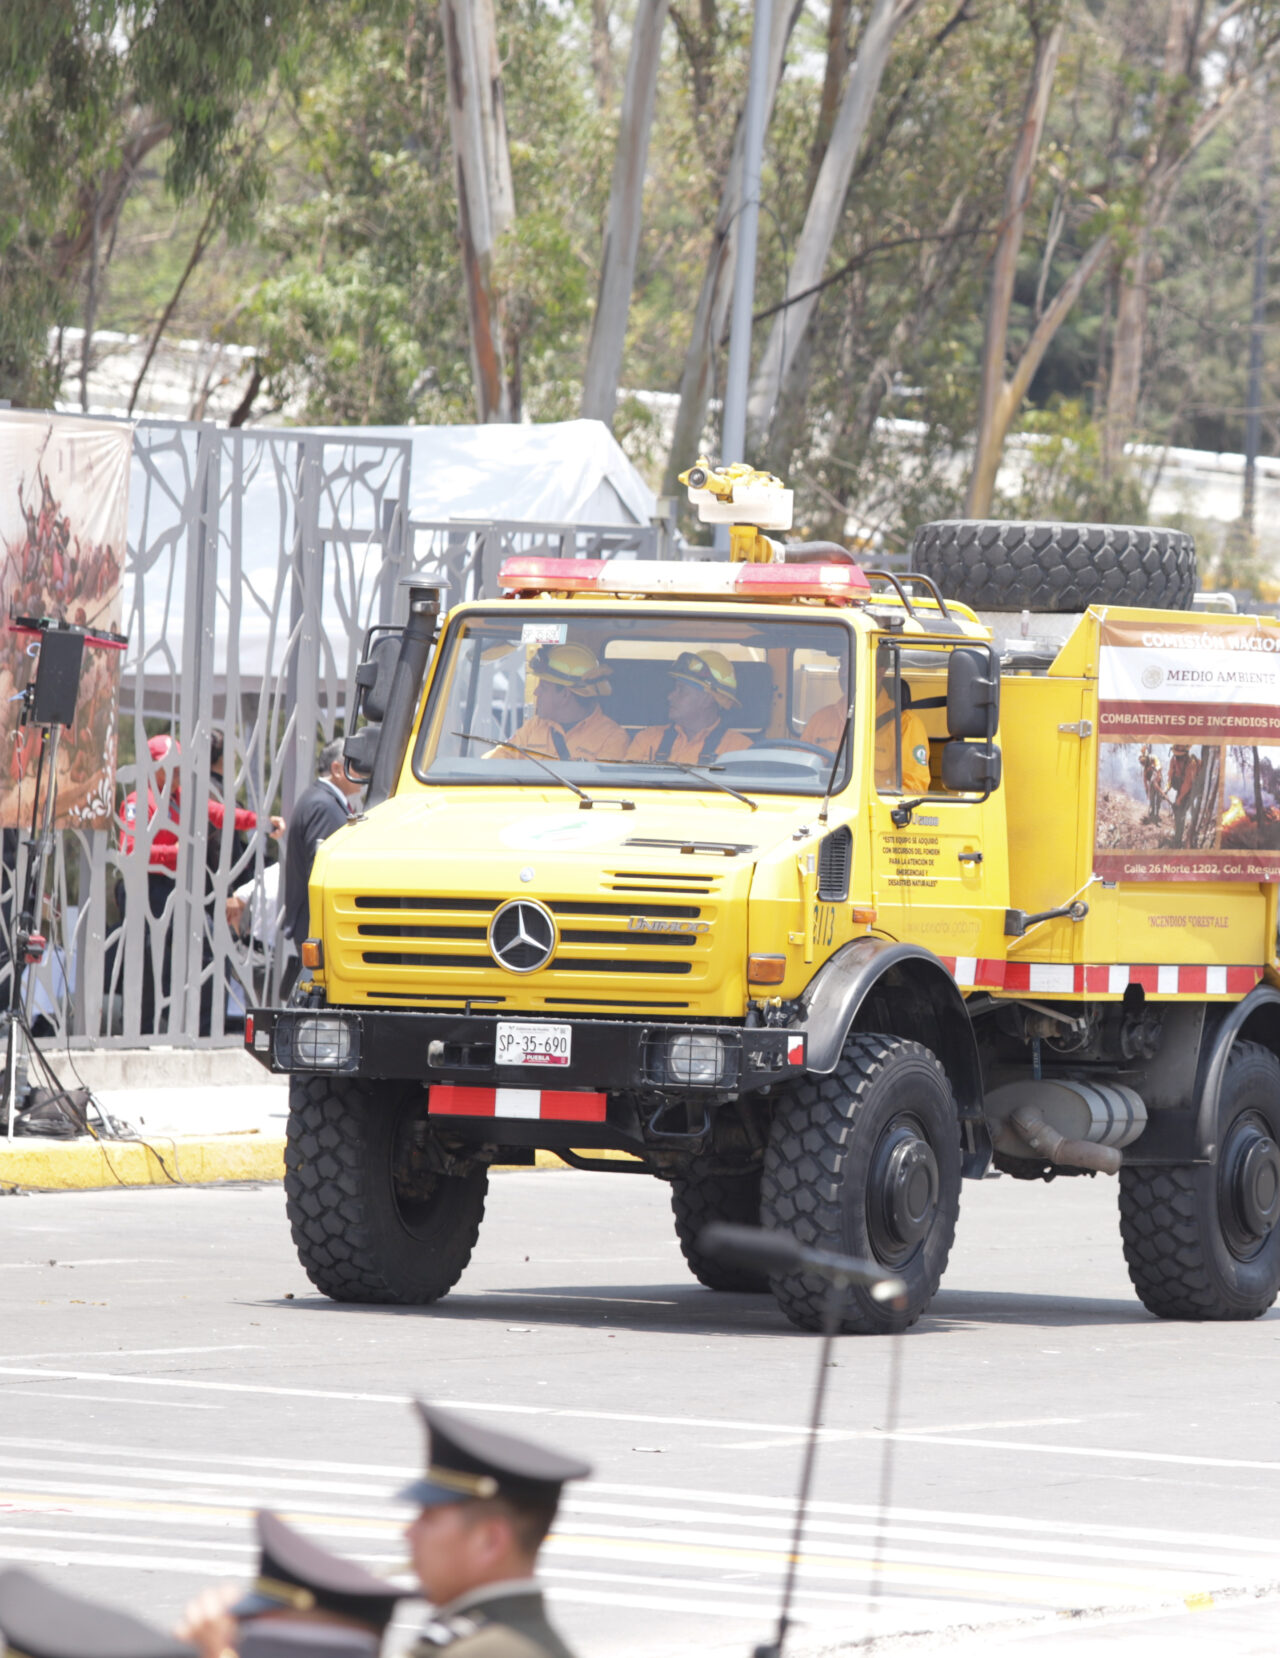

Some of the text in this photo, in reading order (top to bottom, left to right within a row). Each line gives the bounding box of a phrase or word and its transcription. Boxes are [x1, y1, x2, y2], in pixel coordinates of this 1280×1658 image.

[1141, 631, 1225, 649] COMISIÓN
[1166, 669, 1277, 685] MEDIO AMBIENTE
[1100, 713, 1186, 726] COMBATIENTES
[1188, 715, 1205, 726] DE
[1207, 715, 1269, 728] INCENDIOS
[1124, 863, 1147, 875] Calle
[1148, 864, 1161, 875] 26
[1162, 864, 1192, 875] Norte
[1192, 864, 1221, 876] 1202,
[1223, 864, 1244, 875] Col.
[499, 1034, 567, 1054] SP-35-690
[527, 1054, 551, 1062] PUEBLA
